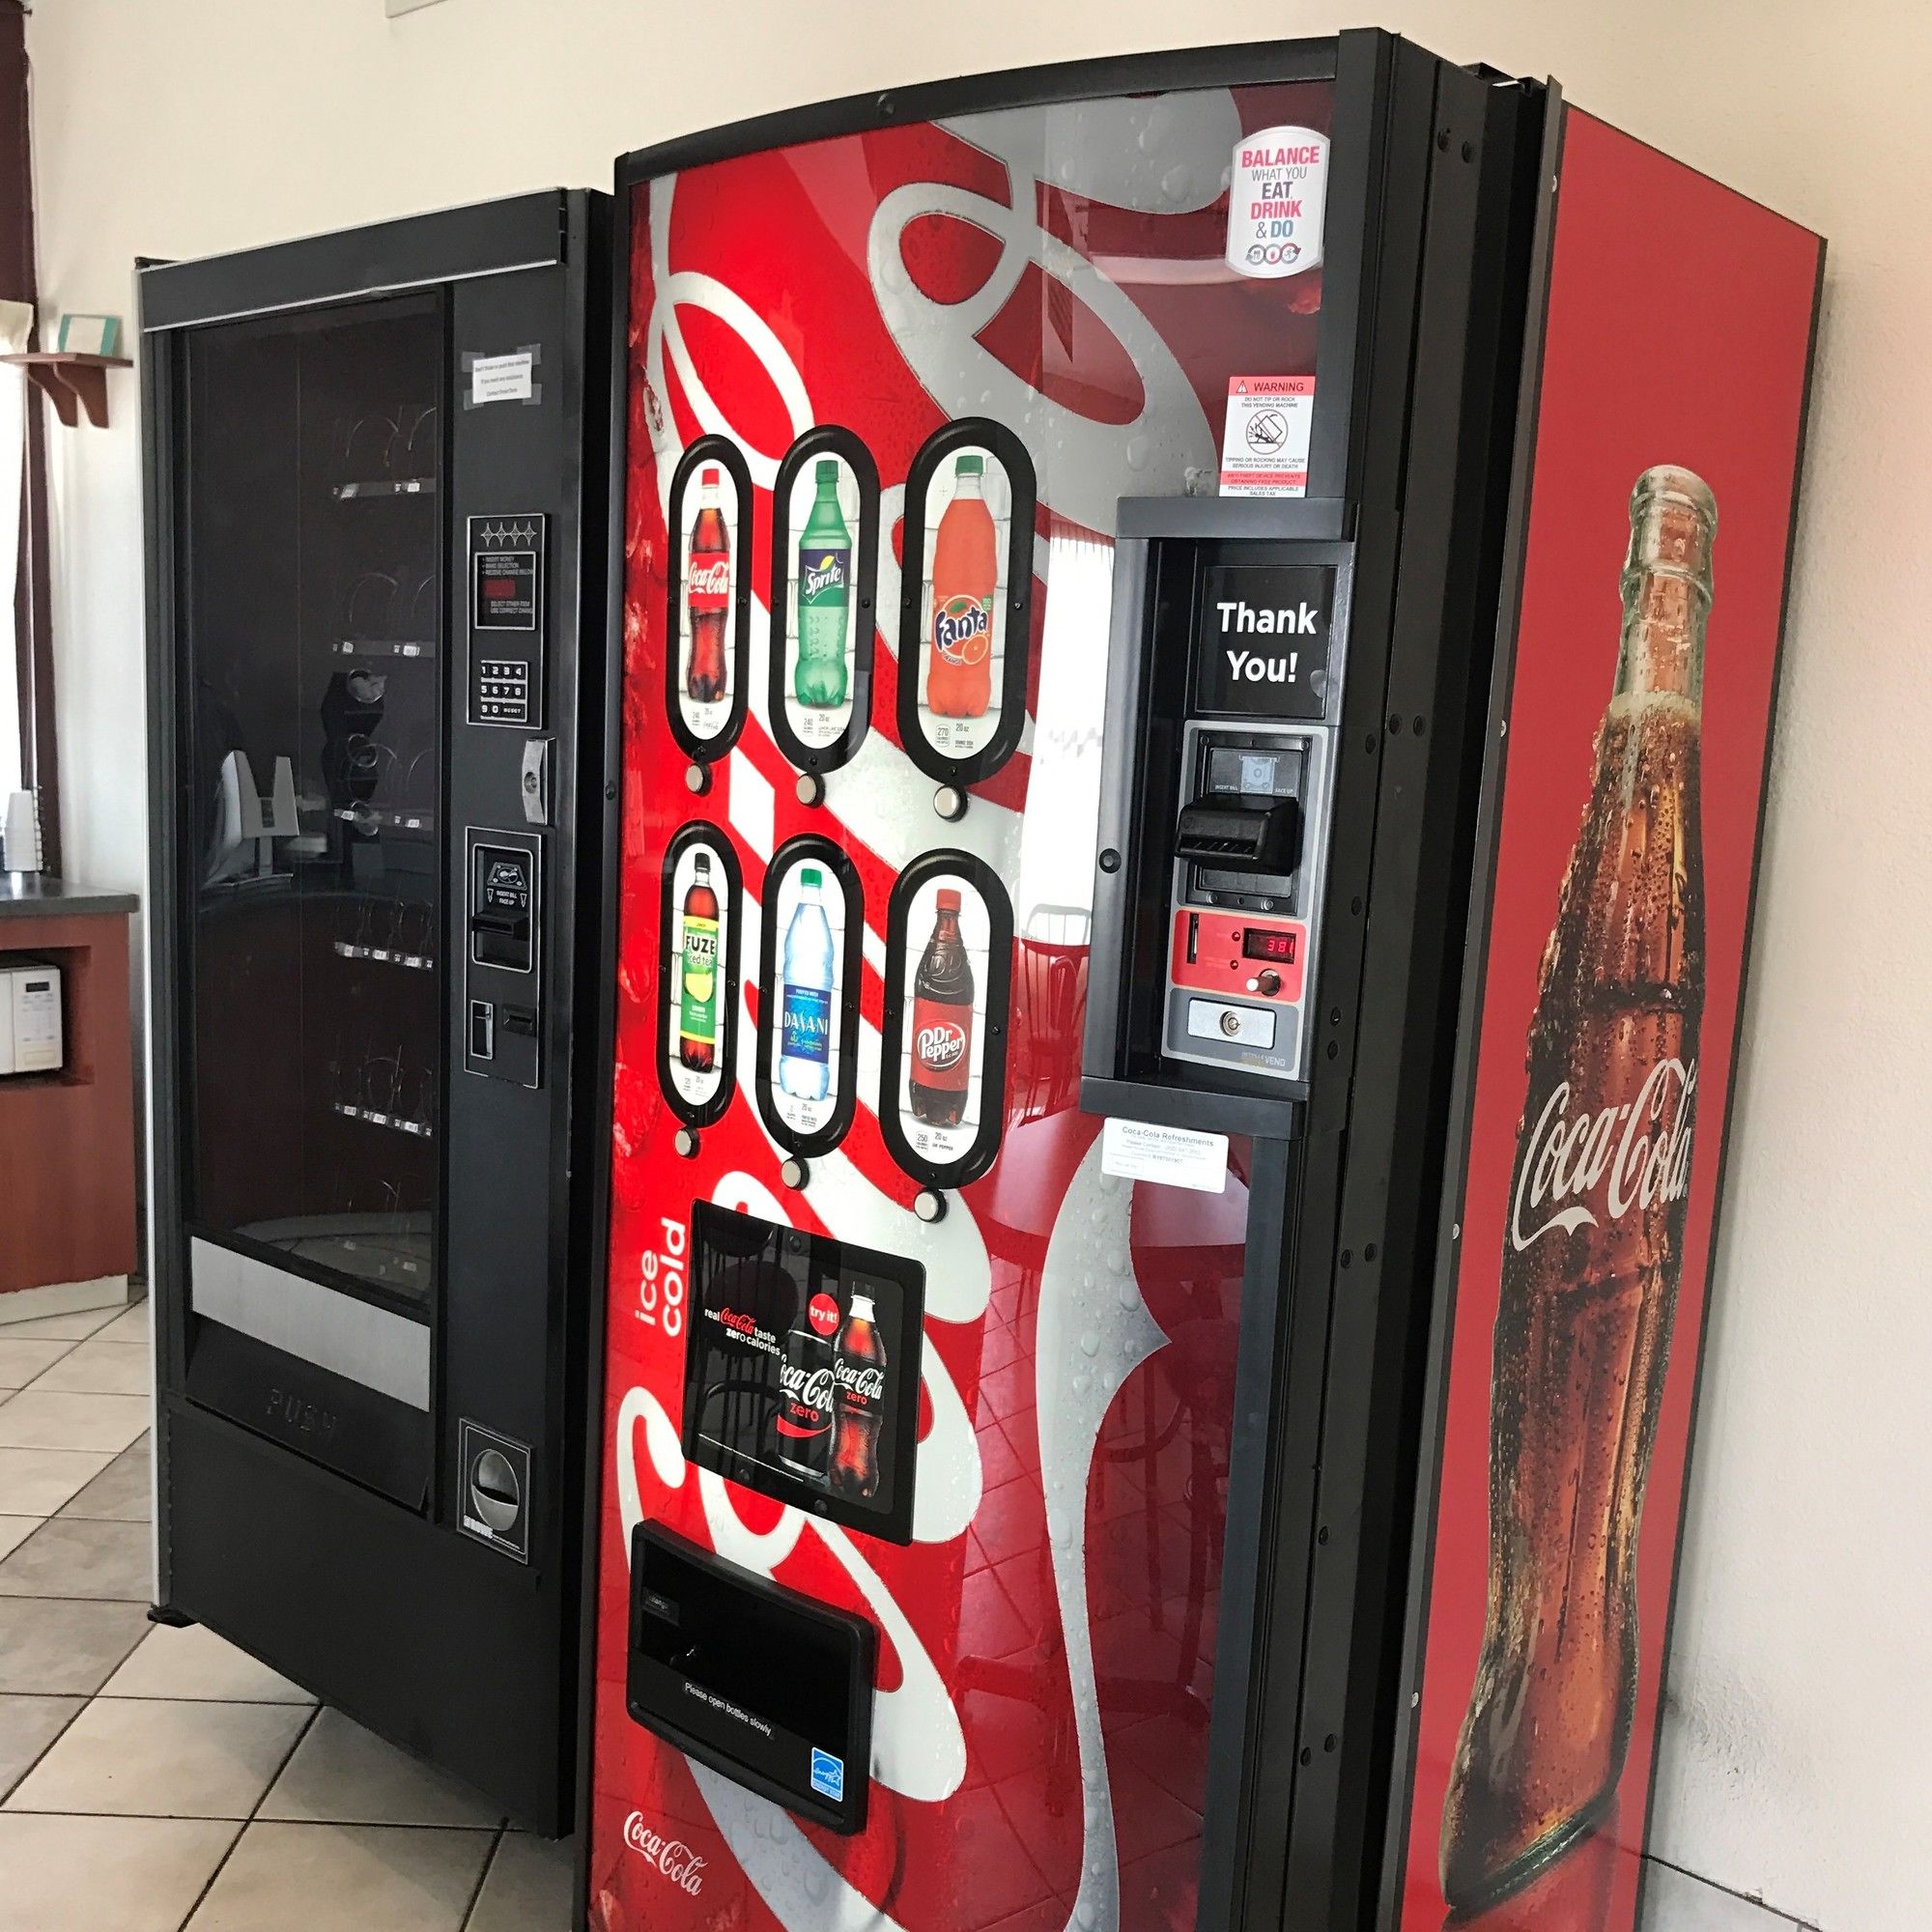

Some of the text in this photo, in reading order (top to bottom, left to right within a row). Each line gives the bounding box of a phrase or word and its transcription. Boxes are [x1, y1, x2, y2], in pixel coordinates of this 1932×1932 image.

[1241, 145, 1321, 168] BALANCE
[1252, 167, 1308, 182] WHAT YOU
[1250, 200, 1303, 219] DRINK
[1256, 220, 1293, 239] & DO
[1254, 383, 1304, 392] WARNING
[689, 561, 729, 594] Coca-Cola
[806, 568, 841, 596] Sprite
[935, 605, 988, 652] Fanta
[1216, 602, 1319, 635] Thank
[493, 666, 498, 675] 2
[503, 667, 510, 675] 3
[1226, 650, 1298, 683] You!
[481, 685, 522, 696] 5 6 7 8
[492, 705, 498, 714] 0
[686, 935, 715, 955] FUZE
[784, 1010, 829, 1036] DASANI
[934, 1026, 952, 1044] Dr
[921, 1029, 963, 1062] Pepper
[1122, 1126, 1213, 1147] Coca-Cola Refreshments
[1512, 1058, 1697, 1252] Coca-Cola
[635, 1249, 659, 1326] ice
[660, 1216, 686, 1337] cold
[704, 1307, 776, 1344] real Coca-Cola taste
[810, 1306, 838, 1324] try it!
[725, 1327, 781, 1355] zero calories
[846, 1391, 867, 1406] zero
[790, 1403, 819, 1422] zero
[685, 1682, 771, 1737] Please open bottles slowly
[623, 1810, 708, 1896] Coca-Cola
